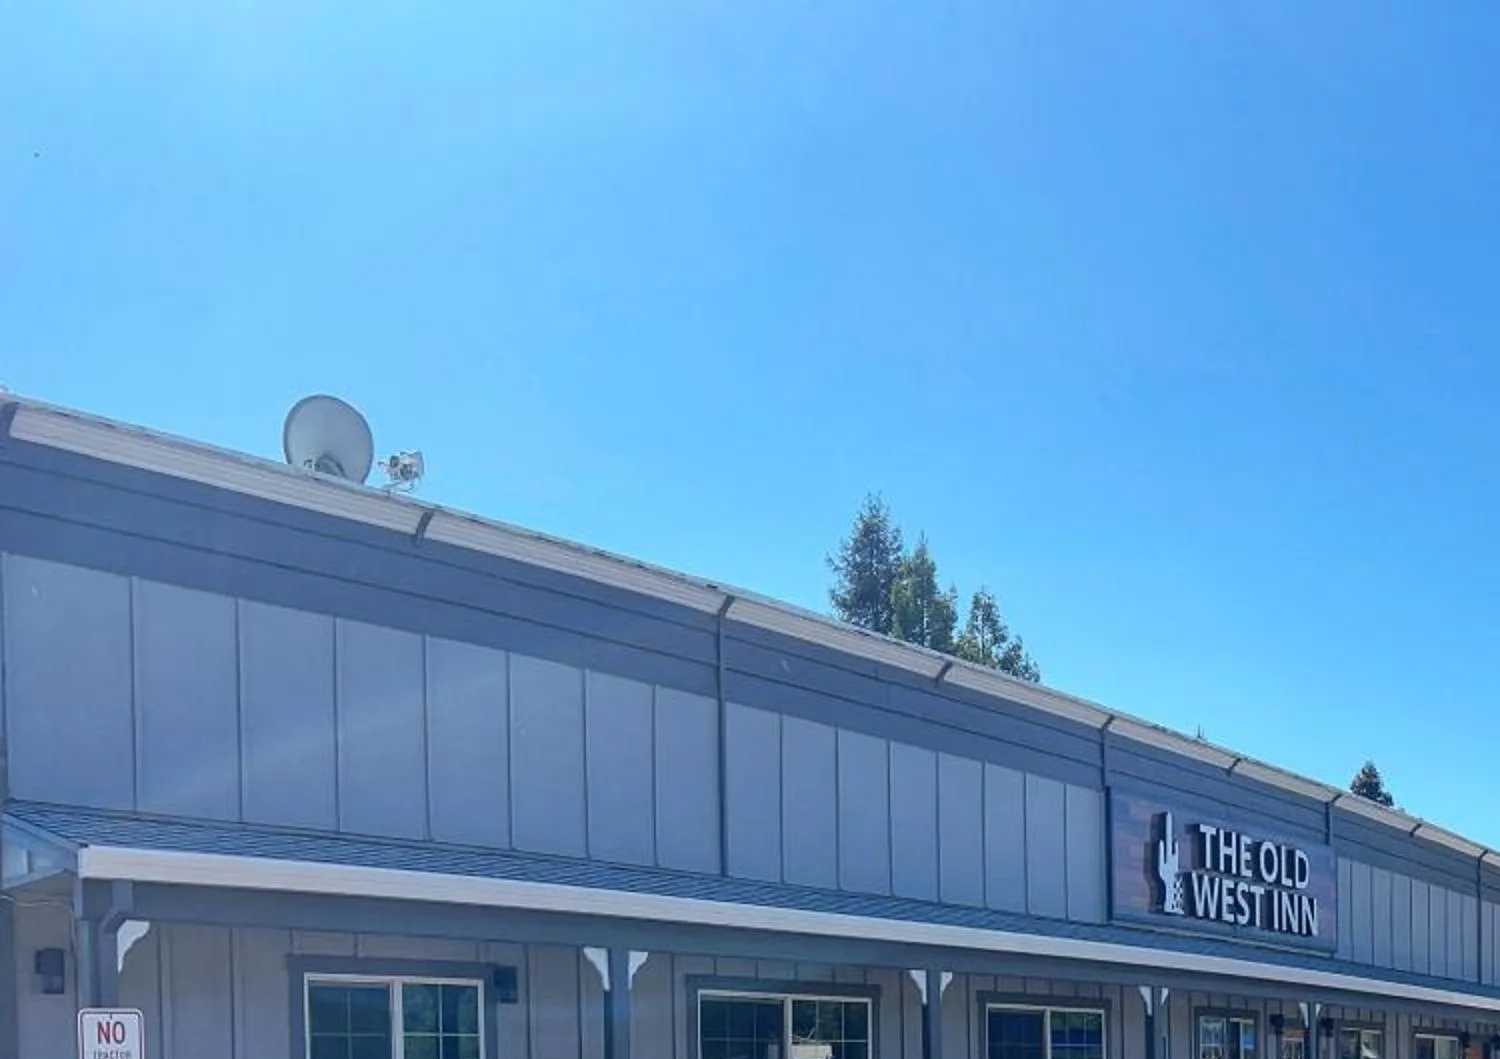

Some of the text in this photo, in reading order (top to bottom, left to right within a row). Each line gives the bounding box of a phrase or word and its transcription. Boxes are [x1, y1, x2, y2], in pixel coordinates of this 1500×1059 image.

[1199, 823, 1310, 889] THE OLD
[1191, 870, 1319, 937] WEST INN
[93, 1050, 132, 1059] TRACTOR
[97, 1021, 125, 1045] NO
